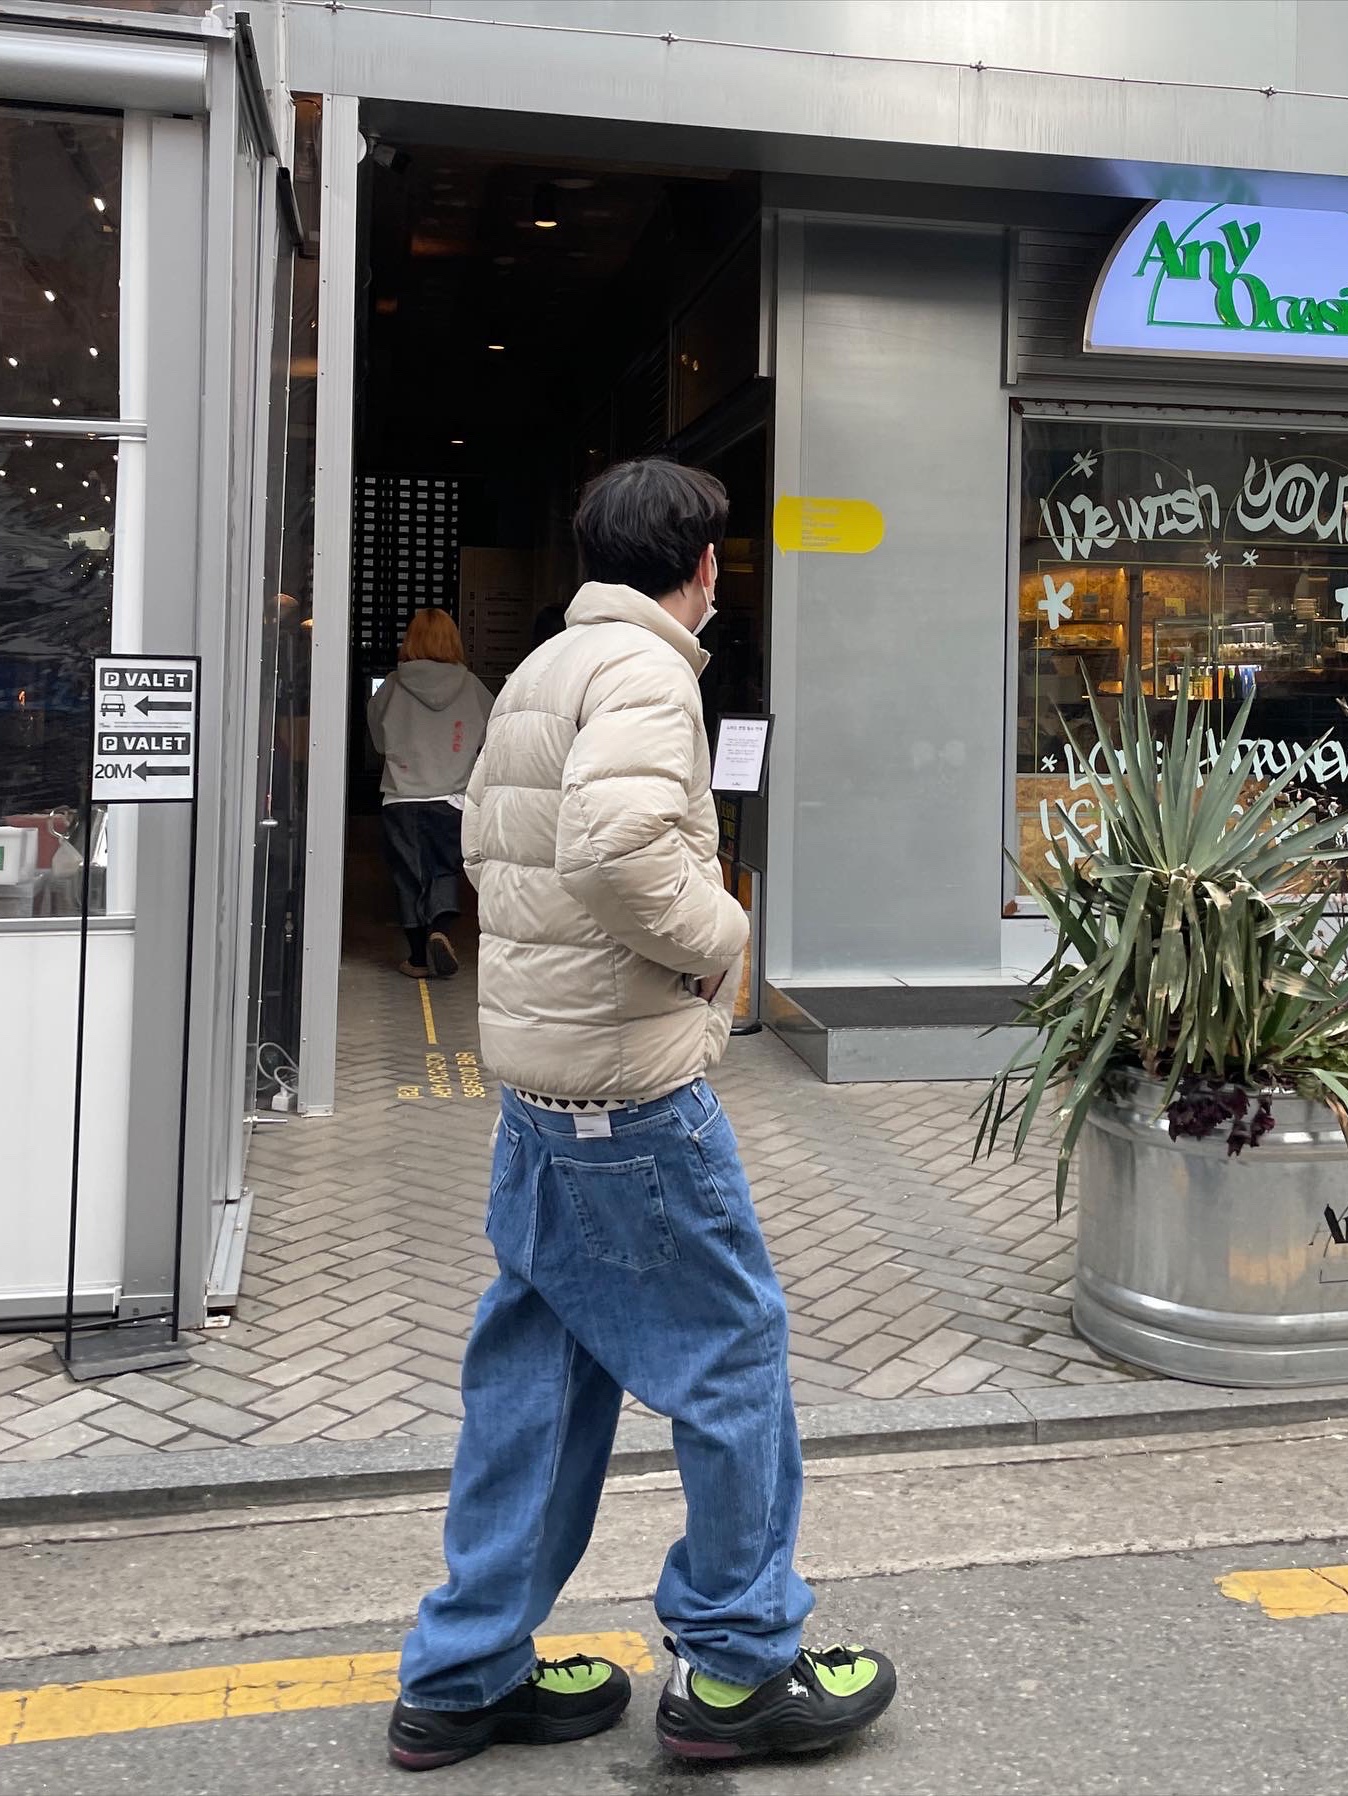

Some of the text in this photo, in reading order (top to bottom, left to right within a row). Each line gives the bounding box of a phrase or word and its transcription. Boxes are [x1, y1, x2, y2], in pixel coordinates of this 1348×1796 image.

[1132, 219, 1261, 281] Any
[1039, 494, 1120, 562] We
[1117, 468, 1220, 544] wish
[125, 672, 188, 687] VALET
[123, 736, 186, 751] VALET
[94, 763, 132, 779] 20M
[458, 1067, 486, 1098] SEAFOOD
